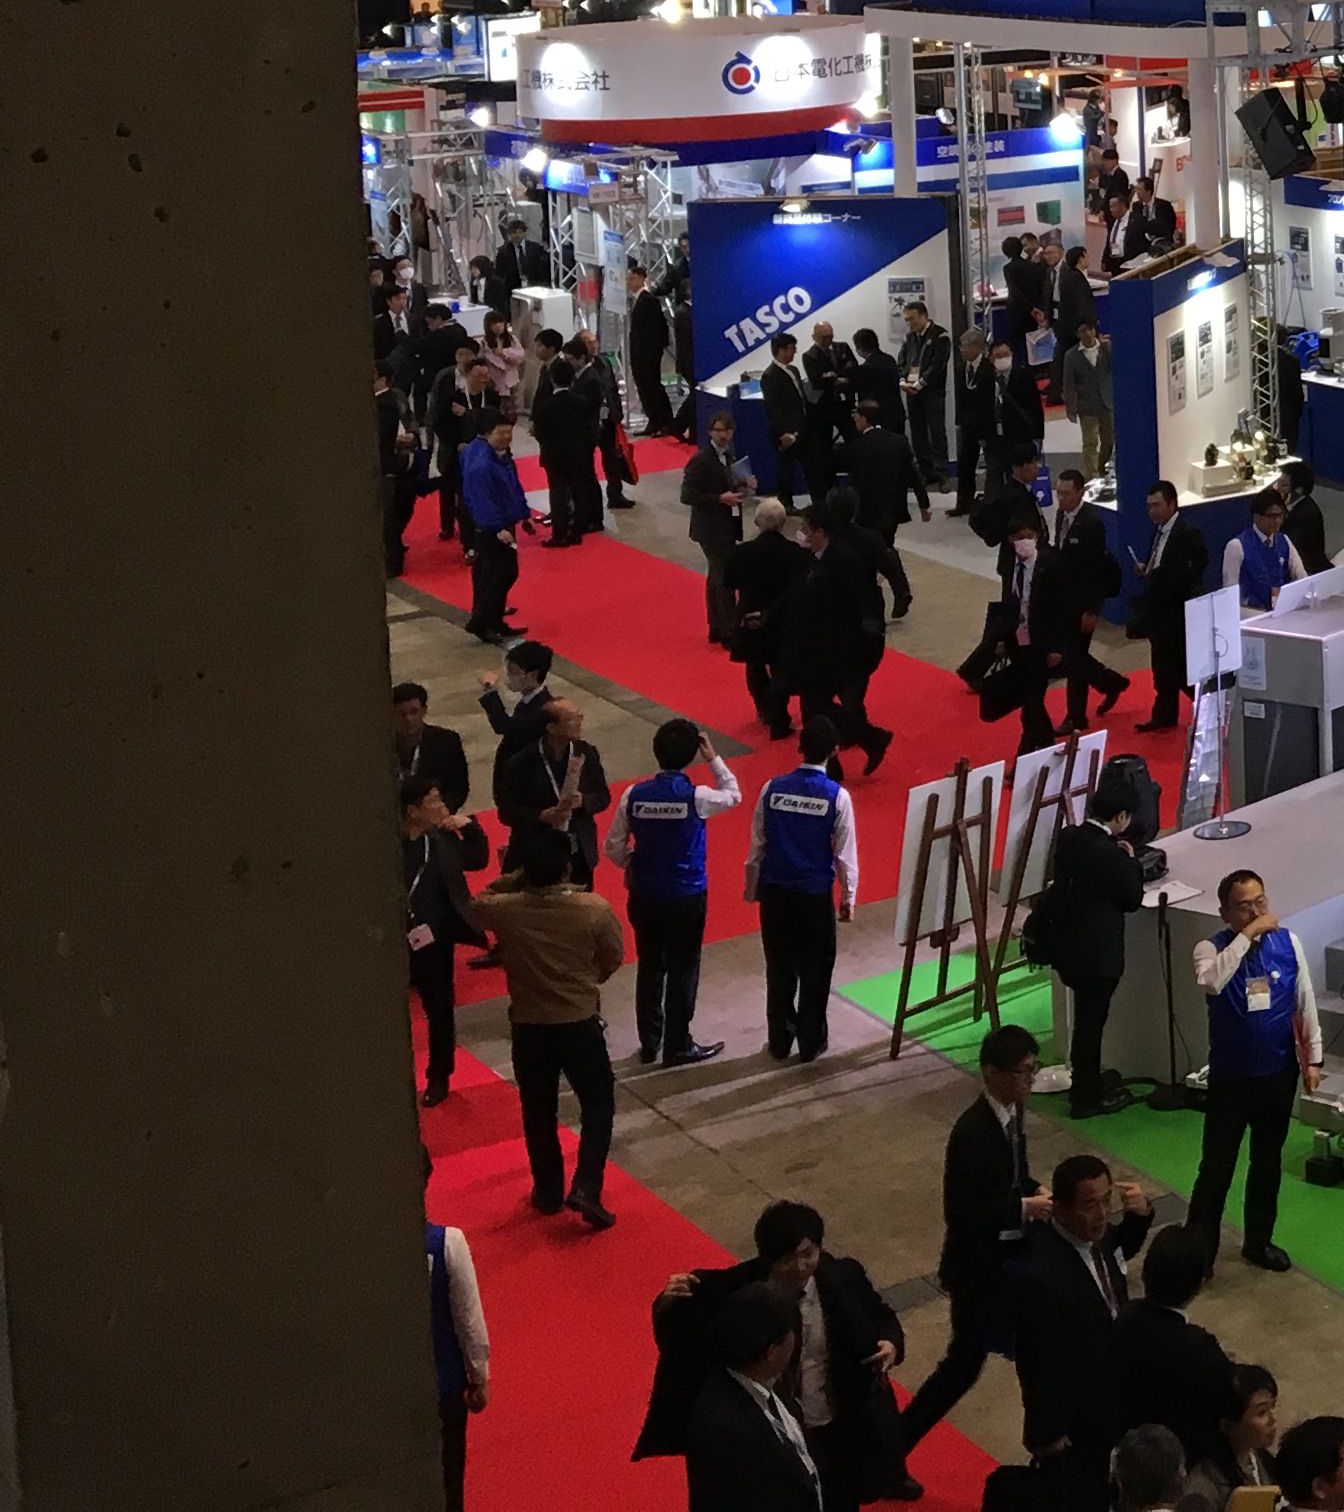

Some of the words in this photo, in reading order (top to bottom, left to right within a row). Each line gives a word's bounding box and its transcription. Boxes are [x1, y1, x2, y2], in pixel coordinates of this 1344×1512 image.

[724, 287, 813, 354] TASCO
[643, 806, 682, 815] DAIKIN
[783, 798, 825, 811] DAIKIN
